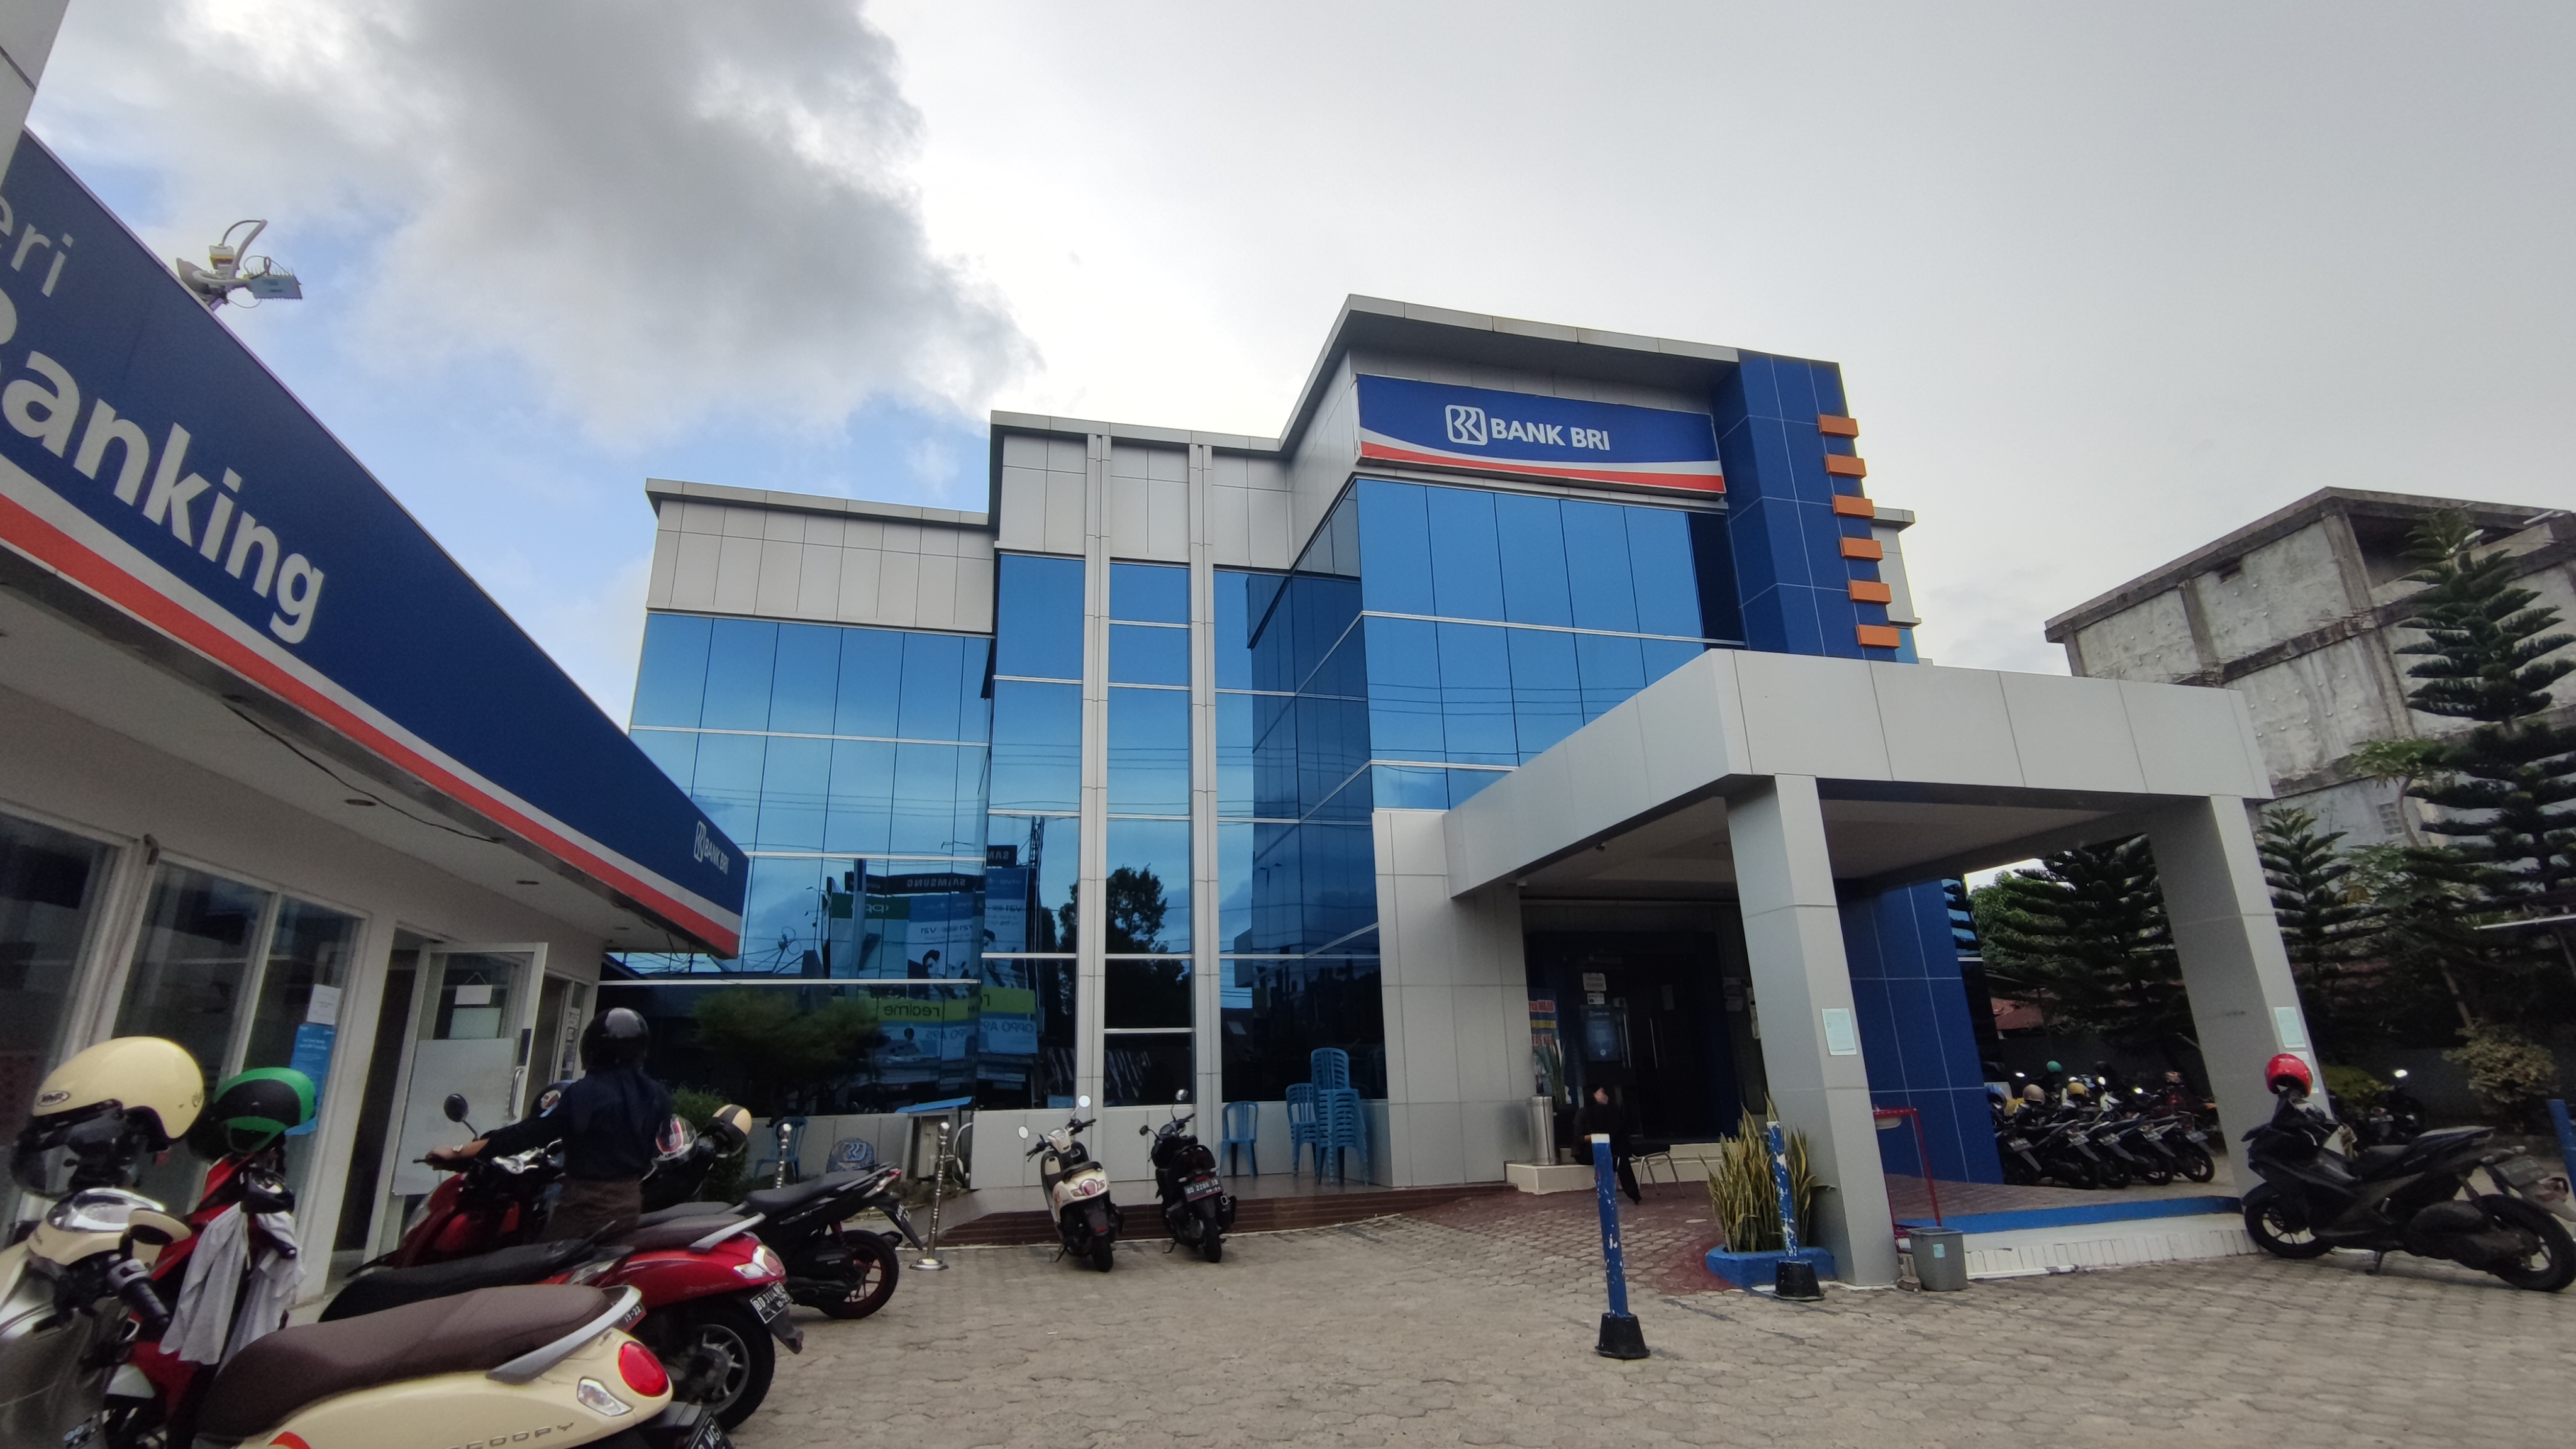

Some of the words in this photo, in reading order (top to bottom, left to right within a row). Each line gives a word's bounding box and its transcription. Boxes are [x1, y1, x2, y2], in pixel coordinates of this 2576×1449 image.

[1491, 418, 1567, 447] BANK
[1570, 426, 1611, 451] BRI
[704, 837, 721, 868] BANK
[719, 852, 730, 875] BRI
[445, 1421, 575, 1449] COOPY
